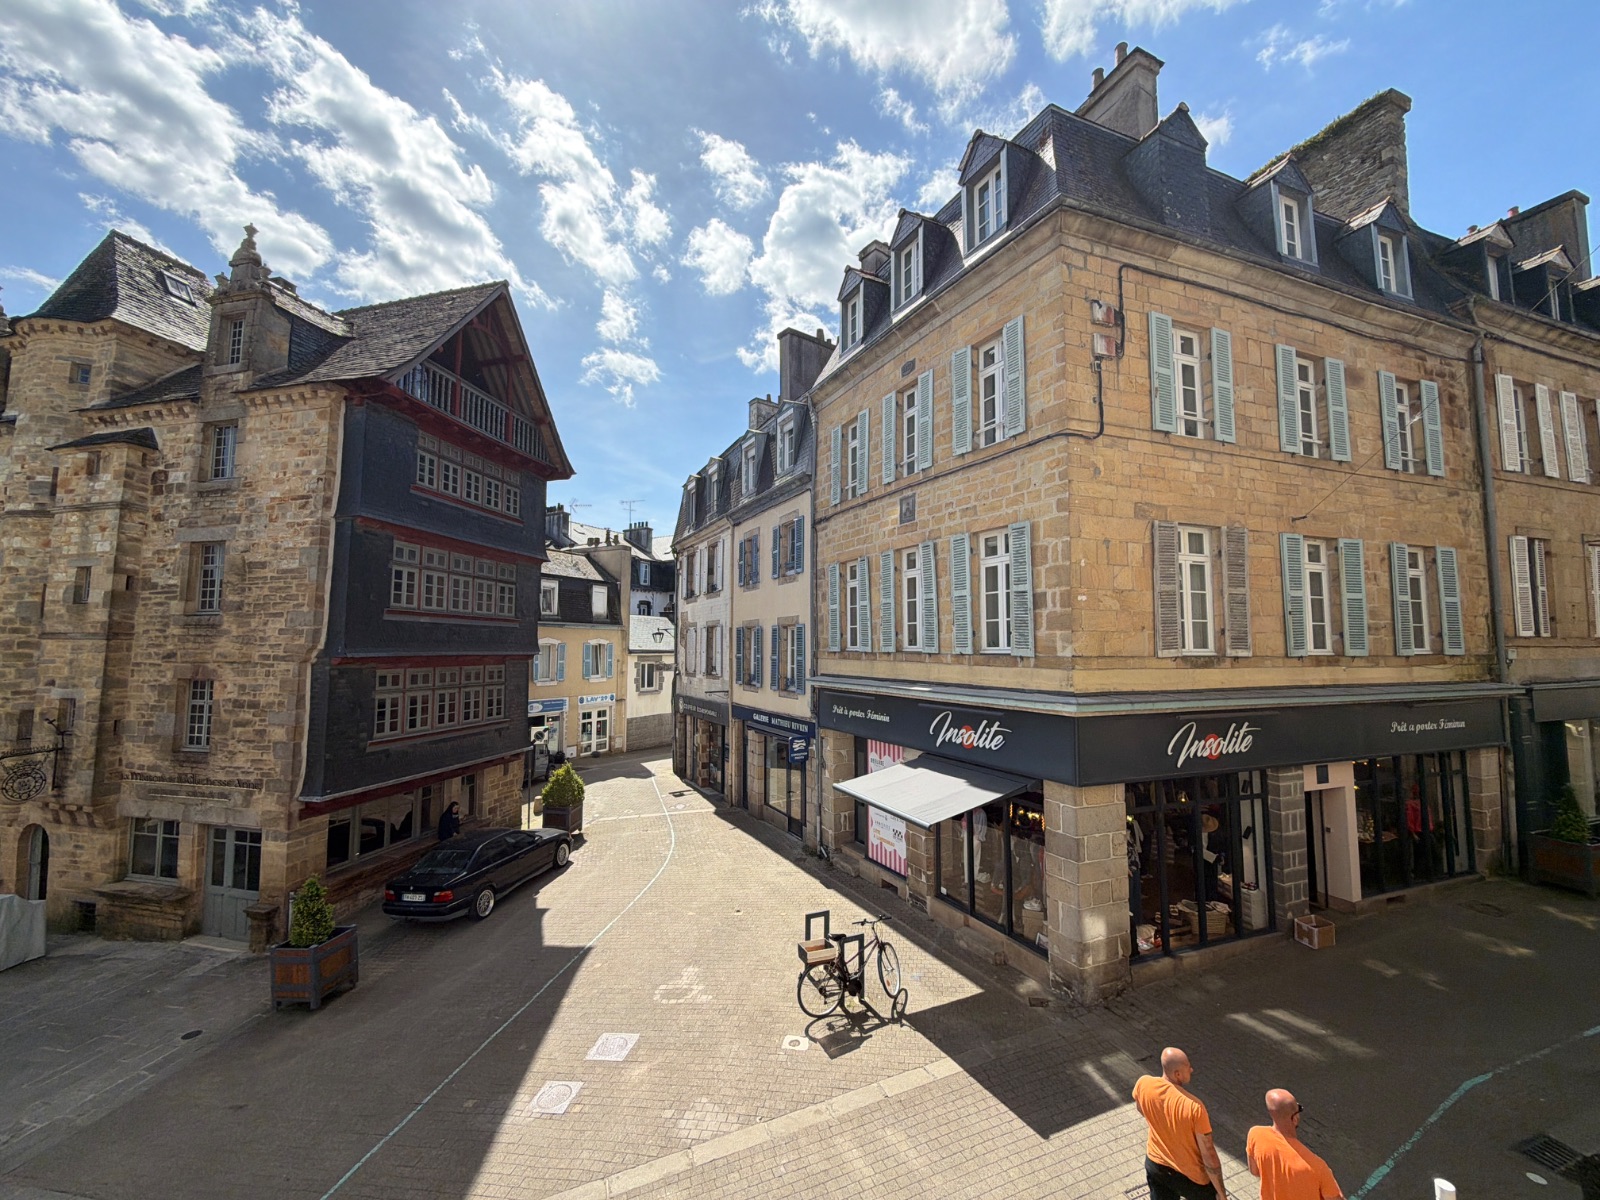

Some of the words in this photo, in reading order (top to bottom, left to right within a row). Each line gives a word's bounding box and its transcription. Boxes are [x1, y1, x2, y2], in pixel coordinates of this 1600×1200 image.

[753, 713, 769, 723] GALERIE
[771, 717, 791, 729] MATHIEU
[832, 704, 844, 715] Prêt
[848, 709, 866, 719] porter
[866, 709, 890, 723] Féminin
[929, 710, 1013, 751] Insolite
[1390, 721, 1408, 733] Prêt
[1415, 721, 1437, 734] porter
[1167, 721, 1262, 769] Insolite
